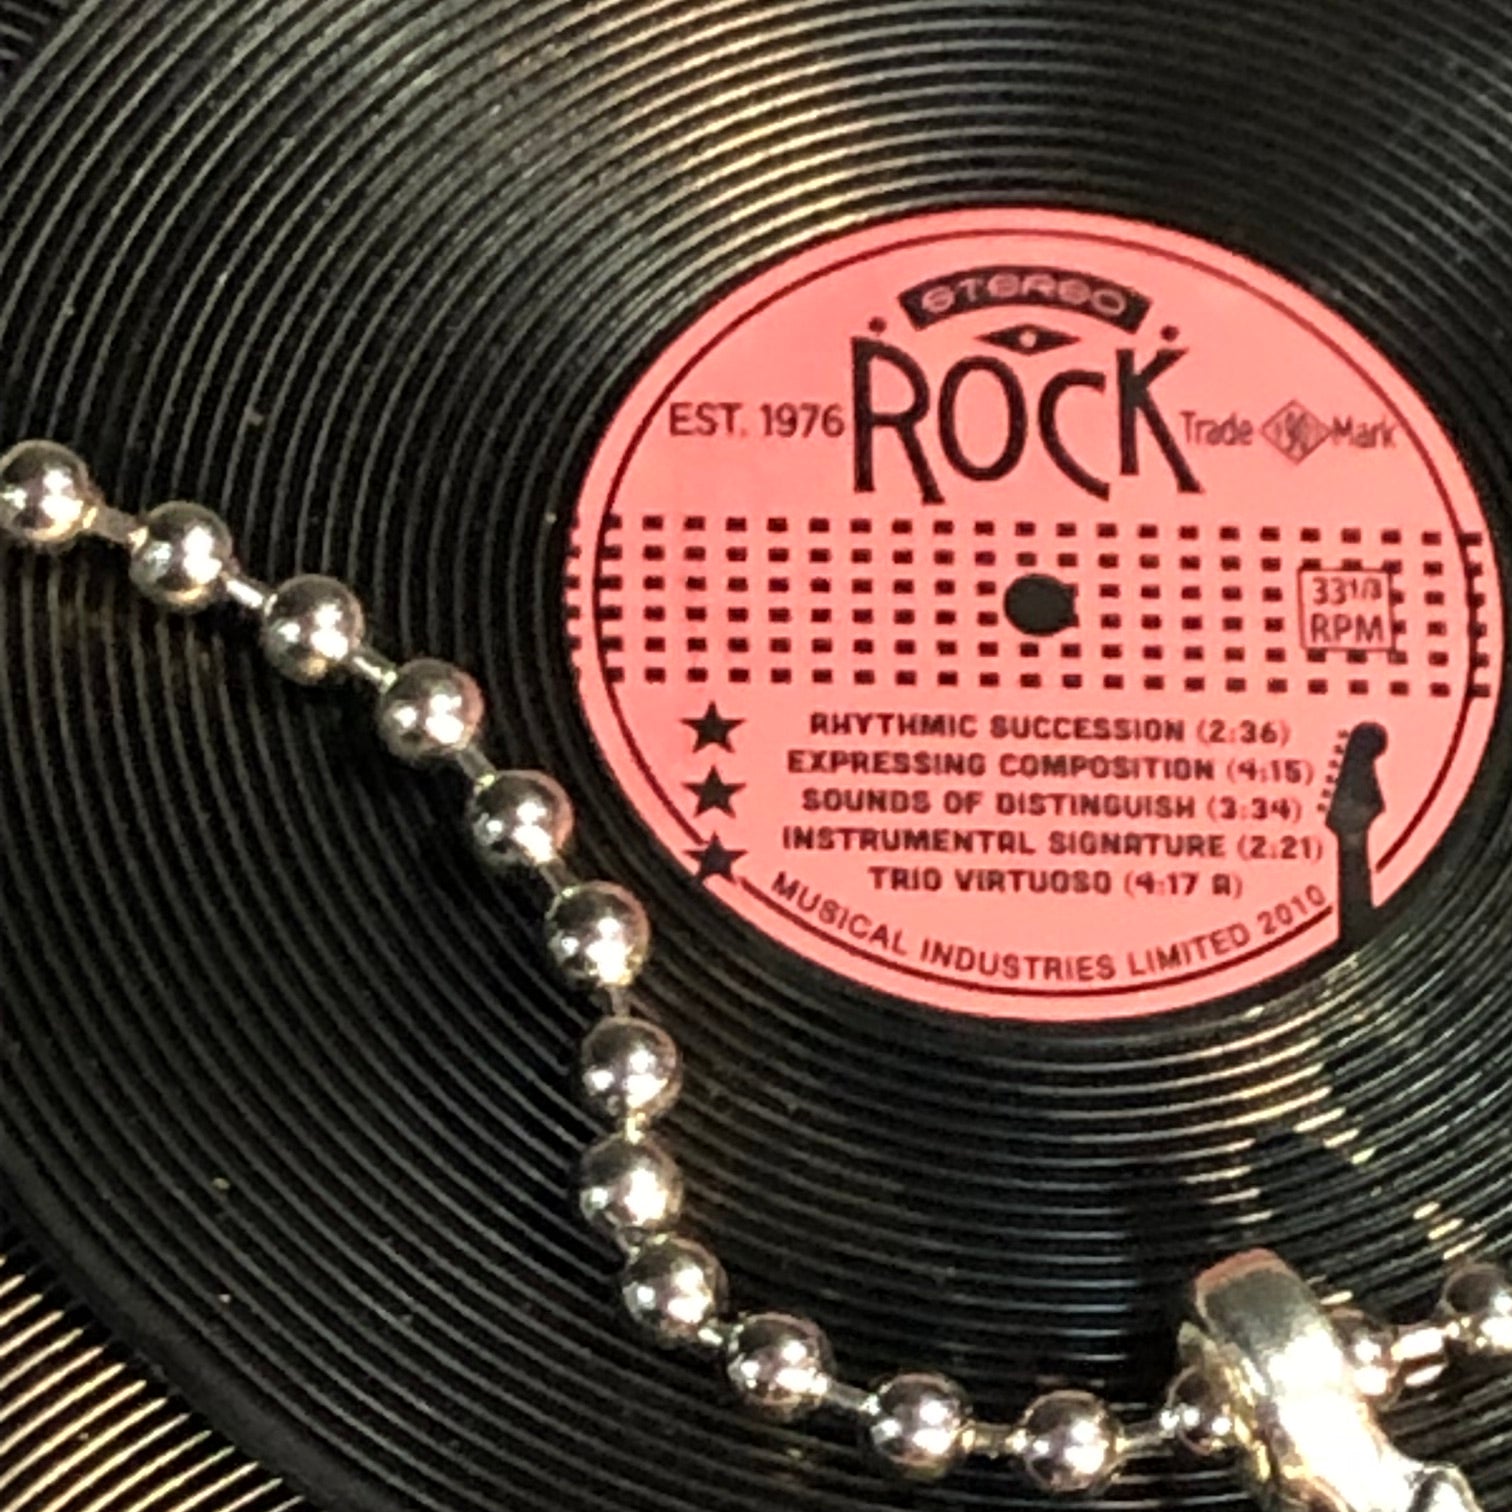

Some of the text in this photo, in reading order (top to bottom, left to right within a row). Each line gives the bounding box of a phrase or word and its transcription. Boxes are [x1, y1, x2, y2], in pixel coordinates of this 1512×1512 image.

[669, 401, 845, 438] EST. 1976
[851, 336, 1205, 506] ROCK
[1180, 410, 1253, 446] Trade
[1331, 415, 1398, 450] Mark
[1310, 613, 1384, 643] RPM
[810, 711, 1290, 747] RHYTHMIC SUCCESSION (2:36)
[787, 749, 1314, 787] EXPRESSING COMPOSITION (4:15)
[801, 787, 1302, 825] SOUNDS OF DISTINGUISH (3:34)
[782, 825, 1323, 863] INSTRUMENTAL SIGNATURE (2:21)
[868, 865, 942, 891] TRIO
[955, 868, 1112, 896] VIRTUOSO
[1124, 870, 1198, 899] (4:17
[771, 870, 1327, 982] MUSICAL INDUSTRIES LIMITED 2010
